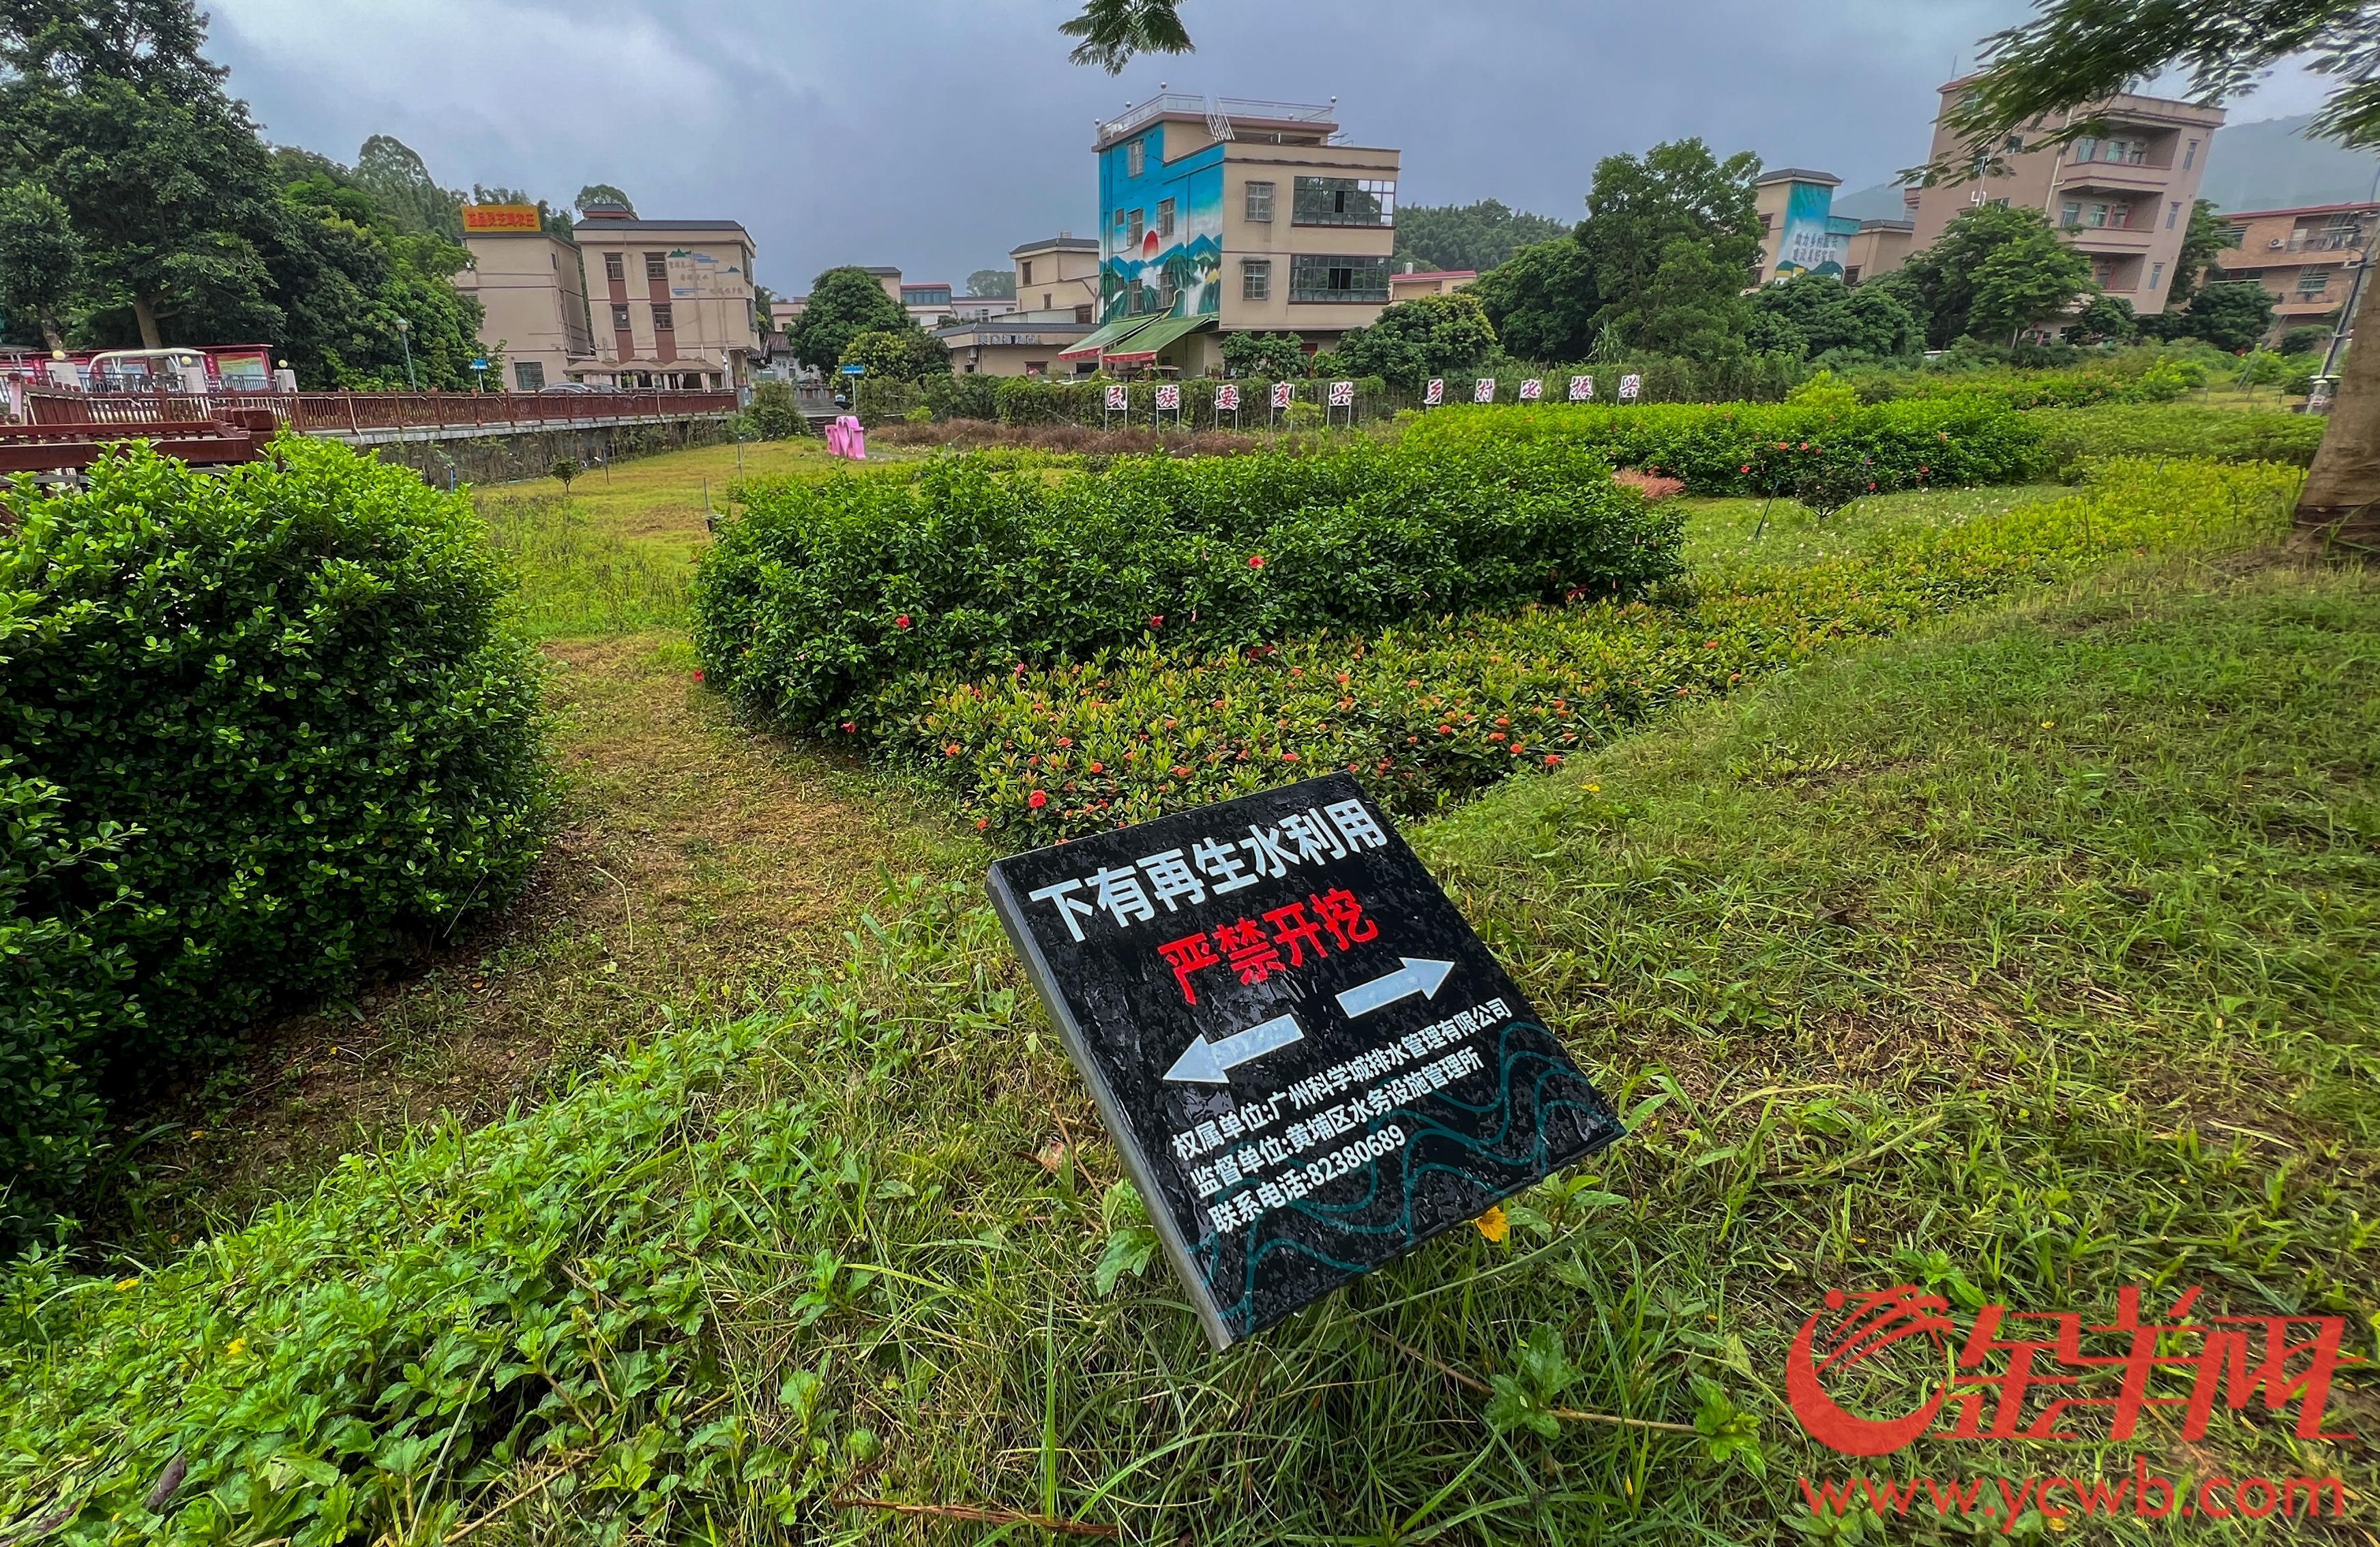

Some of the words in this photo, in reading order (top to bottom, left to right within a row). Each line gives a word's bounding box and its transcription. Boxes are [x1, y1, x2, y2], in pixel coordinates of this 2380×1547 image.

[1106, 381, 1354, 409] 民族要复兴
[1423, 374, 1640, 404] 乡村必振兴
[1028, 798, 1388, 943] 下有再生水利用
[1157, 887, 1378, 1005] 严禁开挖
[1171, 997, 1513, 1161] 权属单位:广州科学城排水管理有限公司
[1189, 1046, 1485, 1198] 监督单位:黄埔区水务设施管理所
[1206, 1124, 1406, 1233] 联系电话:82380689
